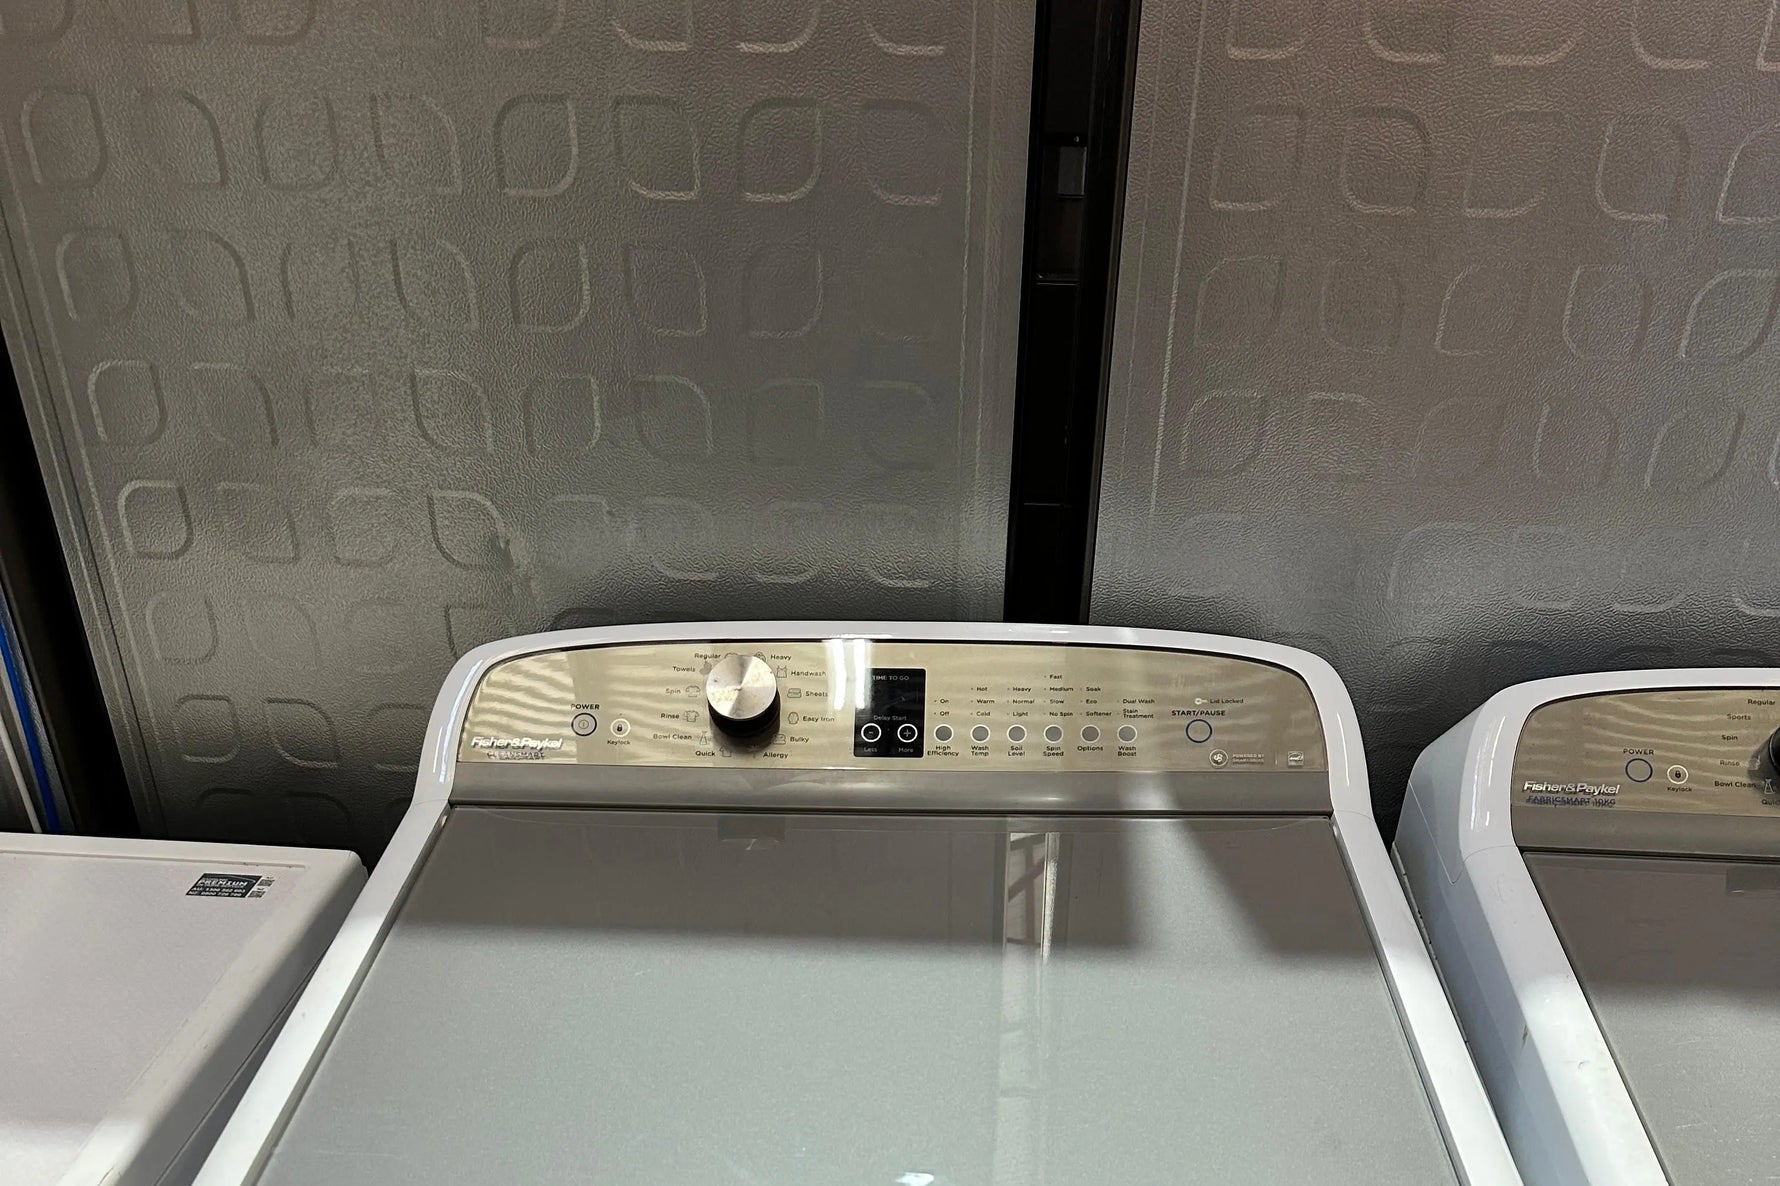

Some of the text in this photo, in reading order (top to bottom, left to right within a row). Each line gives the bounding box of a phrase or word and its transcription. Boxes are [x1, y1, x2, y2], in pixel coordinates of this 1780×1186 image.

[471, 736, 563, 750] Fisher&Paykel
[1522, 780, 1621, 796] Fisher&Paykel
[1527, 796, 1616, 806] FABRICSMART 10KG
